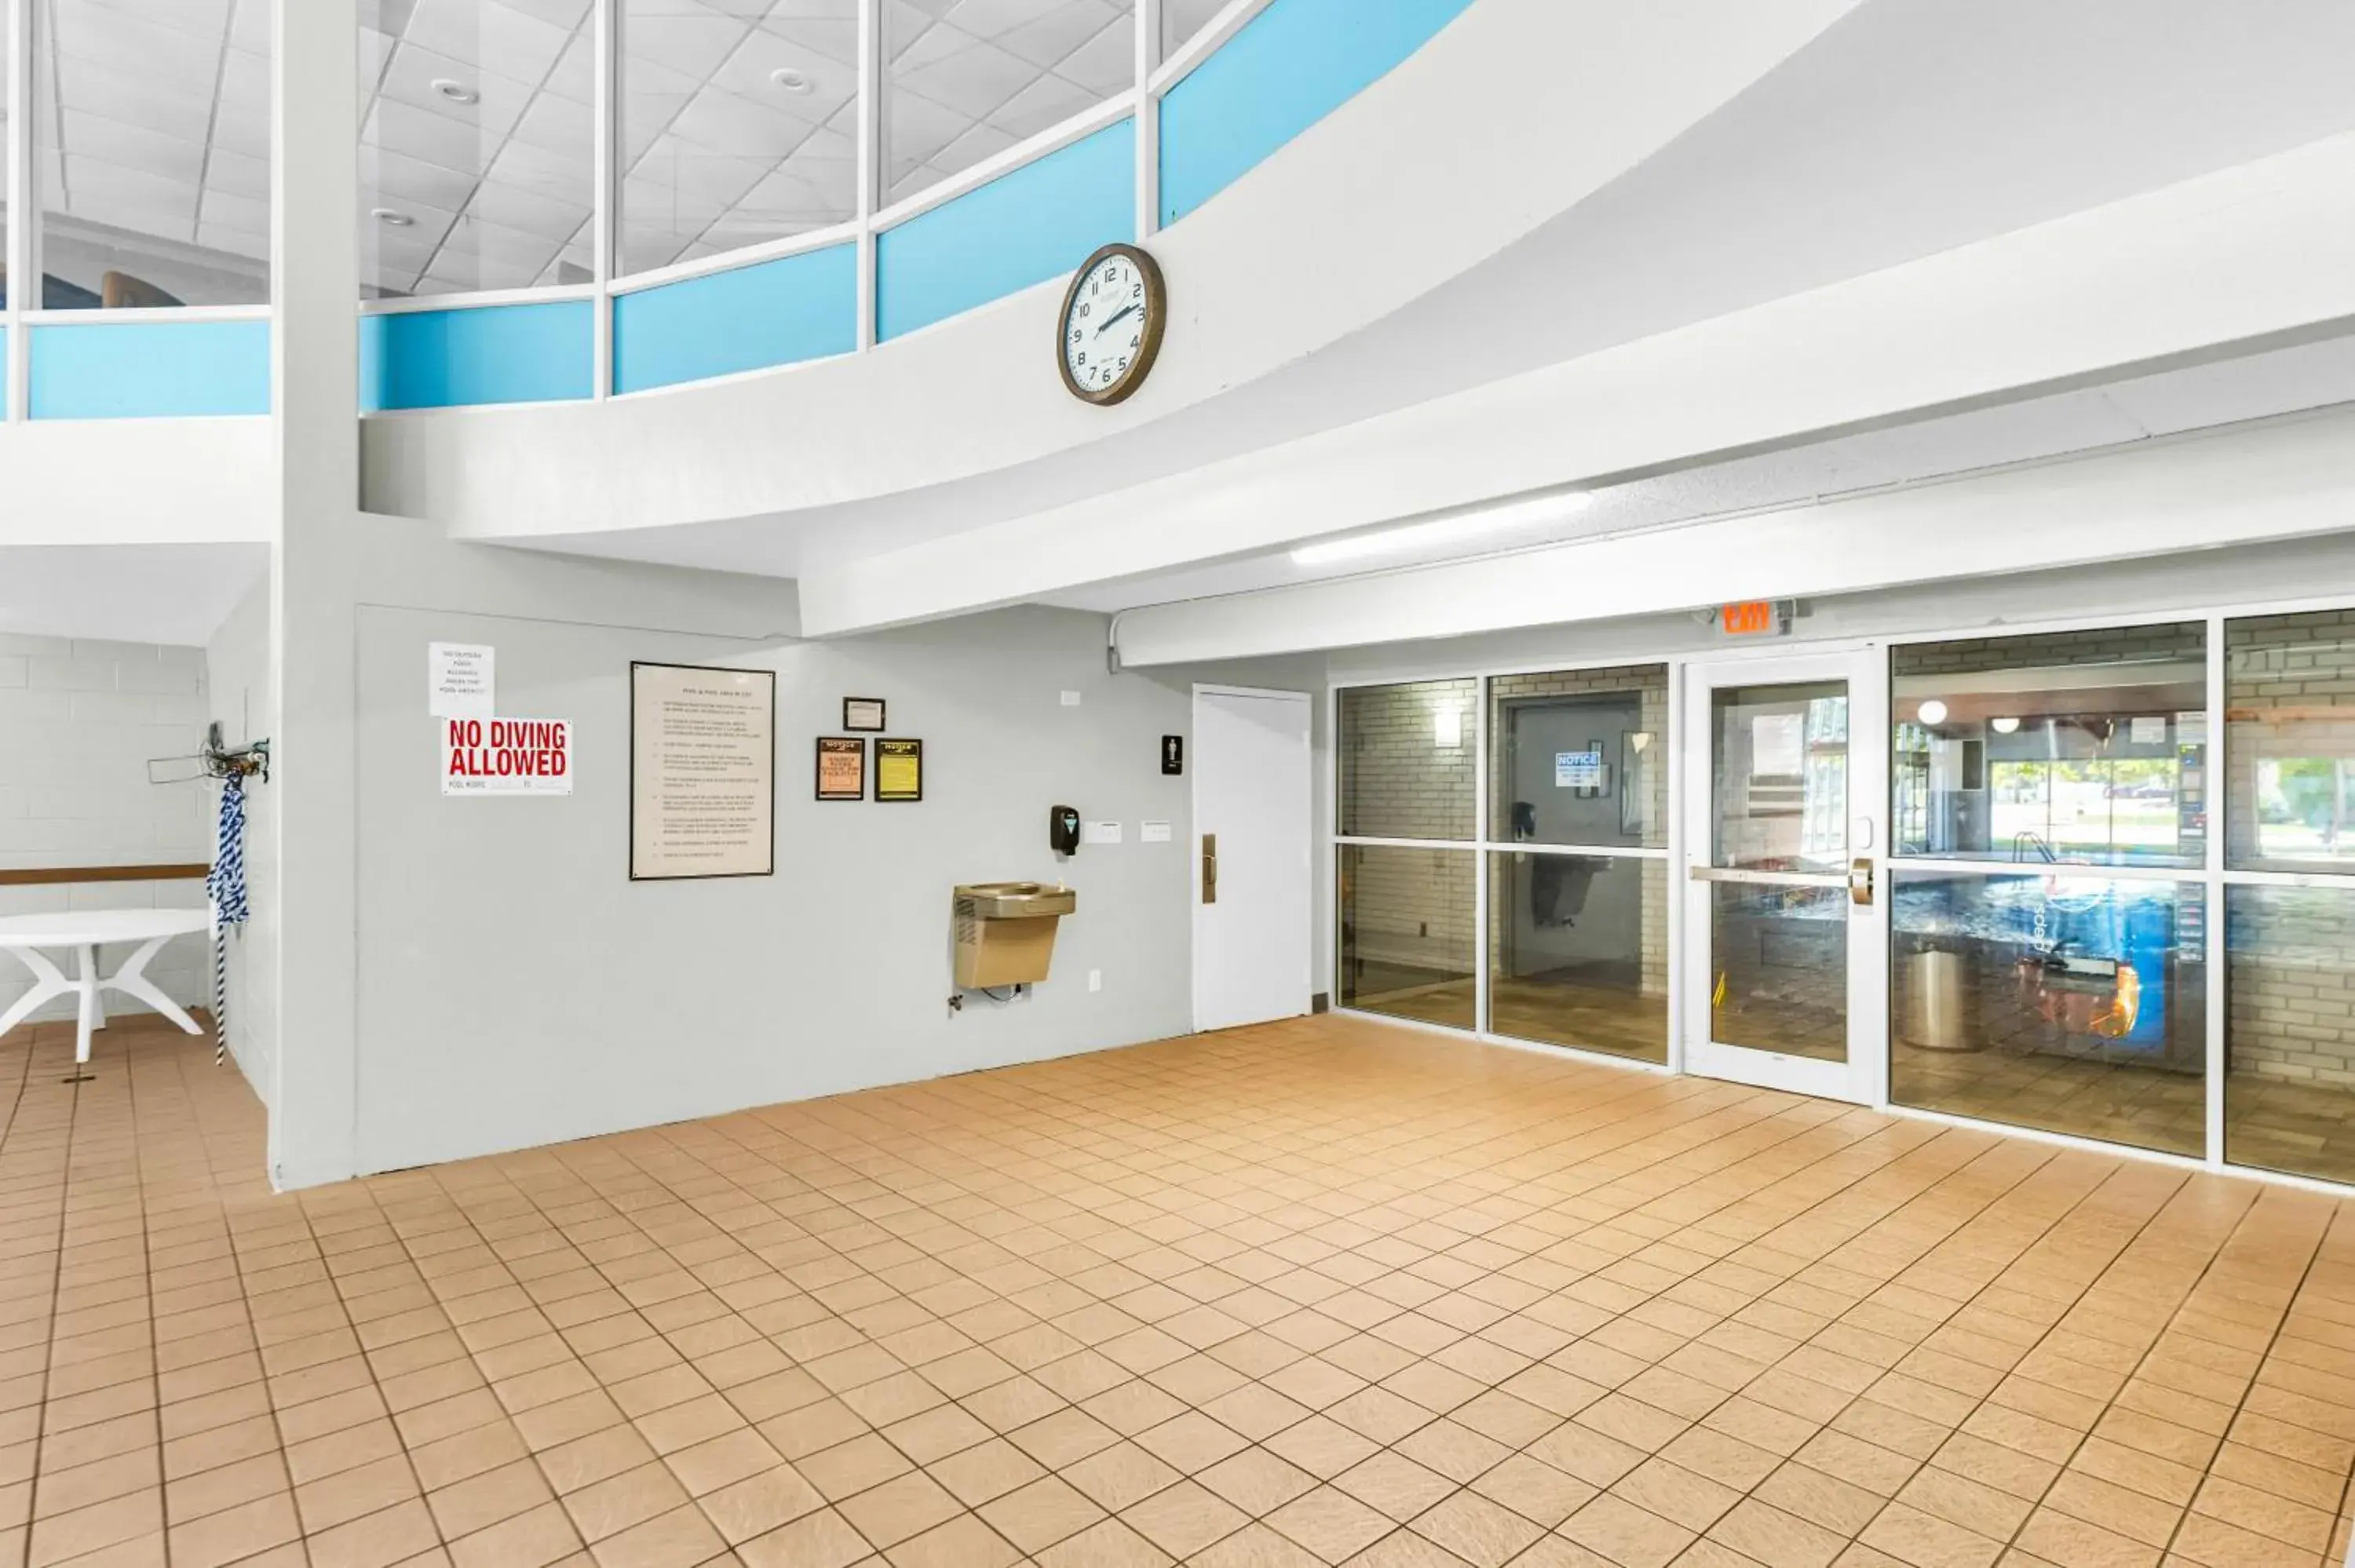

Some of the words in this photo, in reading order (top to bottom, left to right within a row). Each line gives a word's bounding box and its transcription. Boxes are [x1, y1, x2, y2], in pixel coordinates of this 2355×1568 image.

[1104, 268, 1116, 283] 12
[1092, 281, 1099, 296] 11
[1133, 283, 1141, 298] 2
[1079, 303, 1090, 318] 10
[1137, 307, 1145, 321] 3
[1073, 329, 1083, 343] 9
[1130, 335, 1139, 348] 4
[1078, 352, 1086, 365] 8
[1119, 357, 1126, 371] 5
[1090, 366, 1097, 380] 7
[1102, 368, 1111, 382] 6
[450, 720, 481, 748] NO
[491, 721, 566, 749] DIVING
[450, 748, 566, 775] ALLOWED
